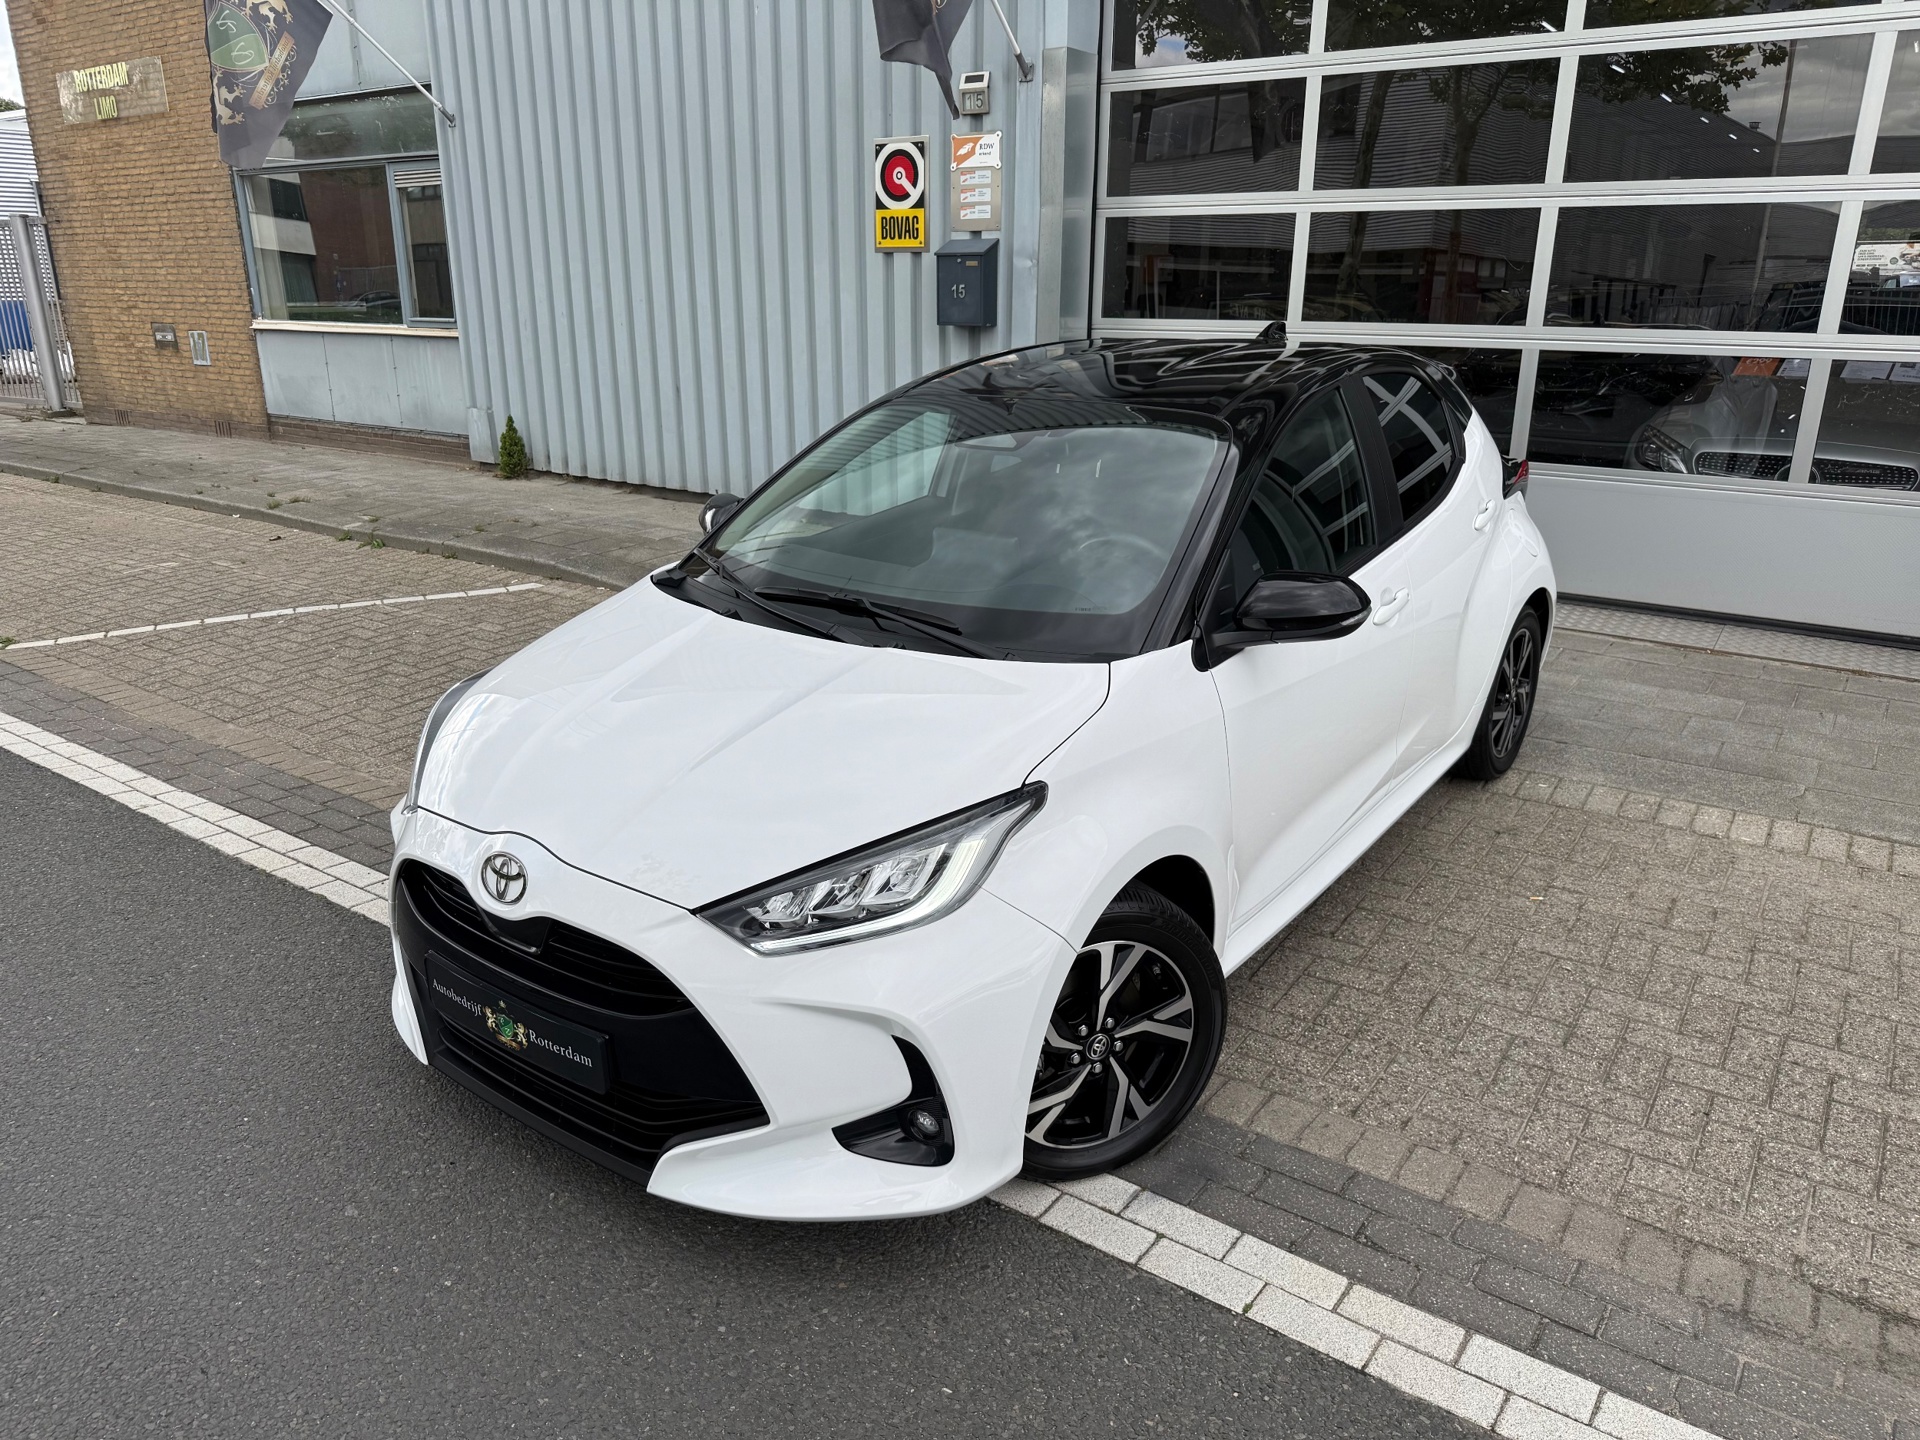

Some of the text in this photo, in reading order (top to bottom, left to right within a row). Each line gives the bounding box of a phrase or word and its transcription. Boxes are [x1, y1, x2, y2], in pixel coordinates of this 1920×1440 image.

[73, 62, 128, 93] ROTTERDAM
[94, 95, 118, 120] LIMO
[967, 93, 983, 108] 15
[979, 142, 995, 150] RDW
[881, 216, 919, 240] BOVAG
[951, 284, 965, 299] 15
[432, 978, 483, 1017] Autobedrijf
[529, 1029, 593, 1068] Rotterdam
